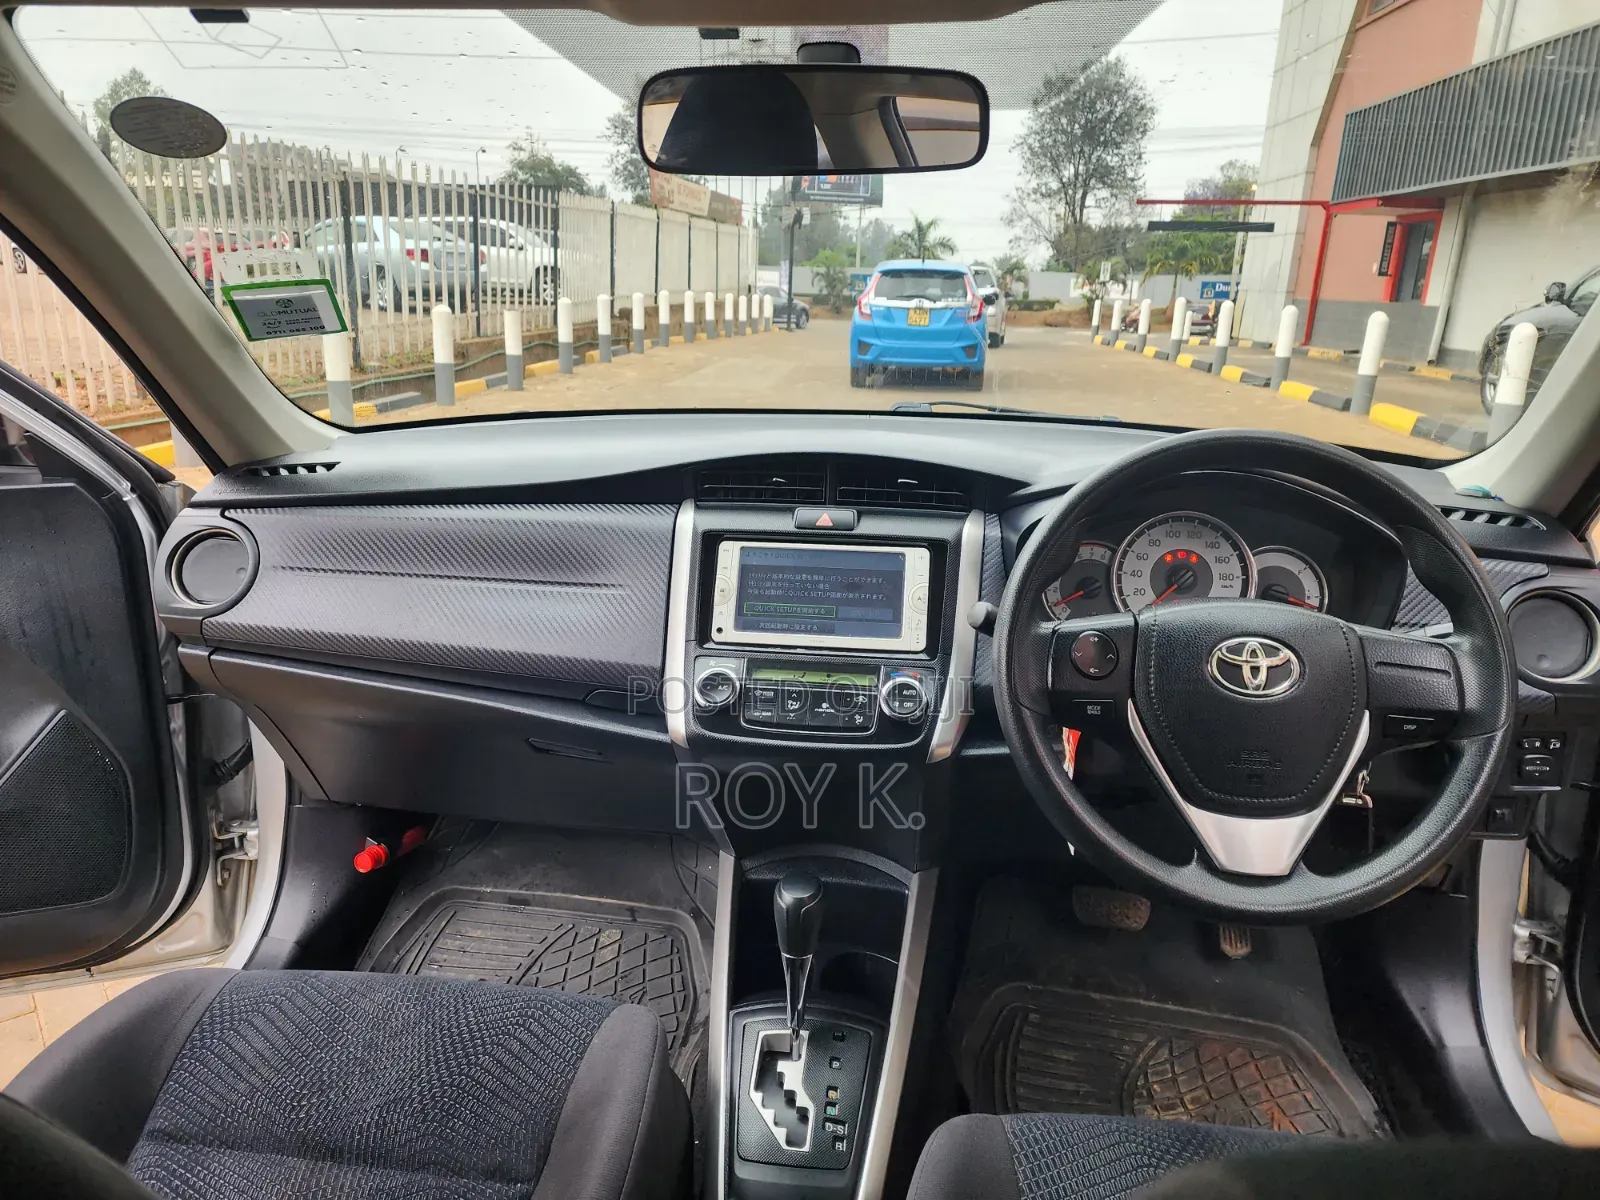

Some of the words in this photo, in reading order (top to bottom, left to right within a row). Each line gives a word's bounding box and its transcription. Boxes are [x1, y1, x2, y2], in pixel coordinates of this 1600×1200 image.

[1165, 530, 1181, 539] 100
[1186, 531, 1203, 539] 120
[1148, 539, 1161, 547] 80
[1205, 541, 1220, 550] 140
[1136, 553, 1149, 561] 60
[1214, 556, 1230, 564] 160
[1130, 570, 1143, 578] 40
[1218, 573, 1234, 581] 180
[1133, 588, 1146, 596] 20
[826, 1106, 836, 1116] N
[825, 1121, 844, 1134] D-S
[835, 1141, 843, 1151] B
